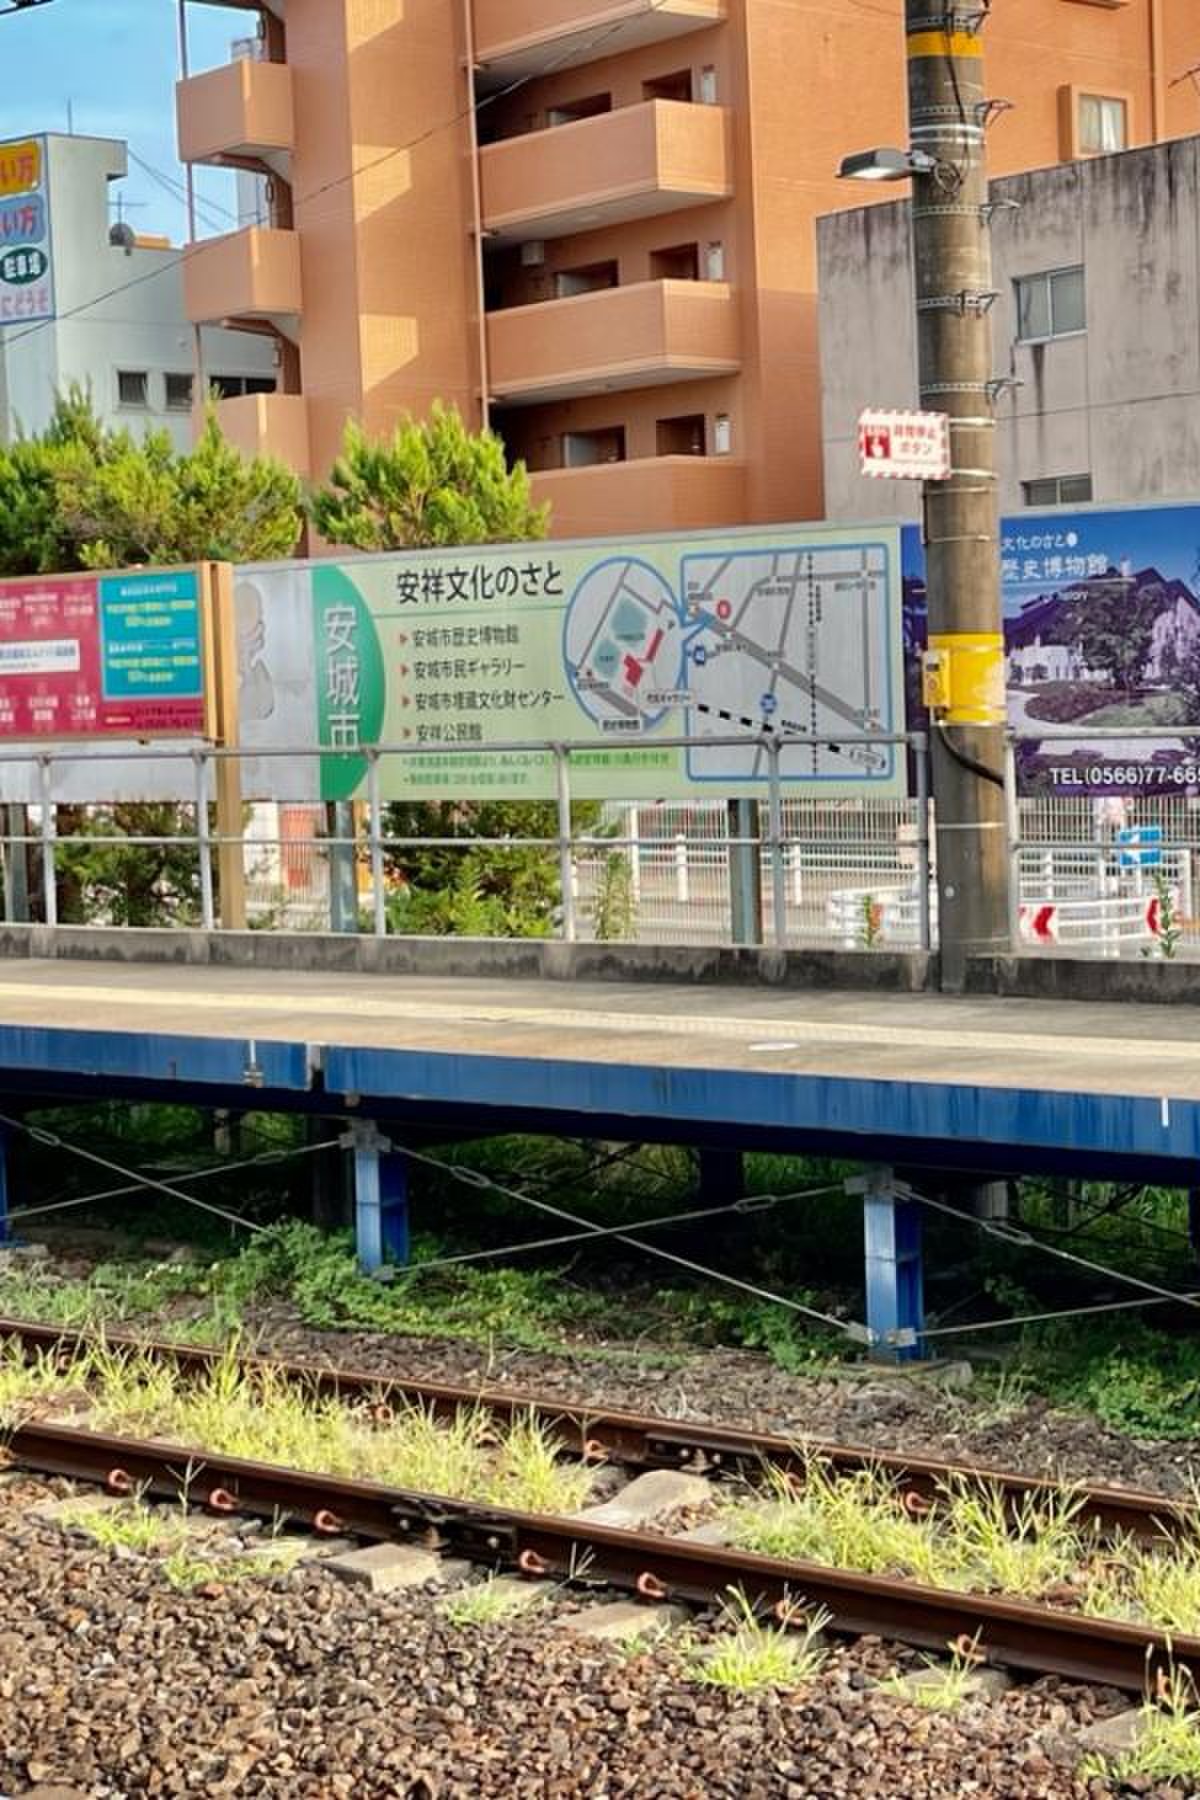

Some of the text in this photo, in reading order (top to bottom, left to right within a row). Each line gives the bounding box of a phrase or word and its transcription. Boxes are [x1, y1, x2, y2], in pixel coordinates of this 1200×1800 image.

[397, 560, 564, 604] 安祥文化のさと
[412, 624, 519, 648] 安城市歴史博物館
[323, 601, 361, 760] 安城市
[414, 658, 526, 680] 安城市民ギャラリー
[415, 688, 565, 711] 安城市埋蔵文化財センター
